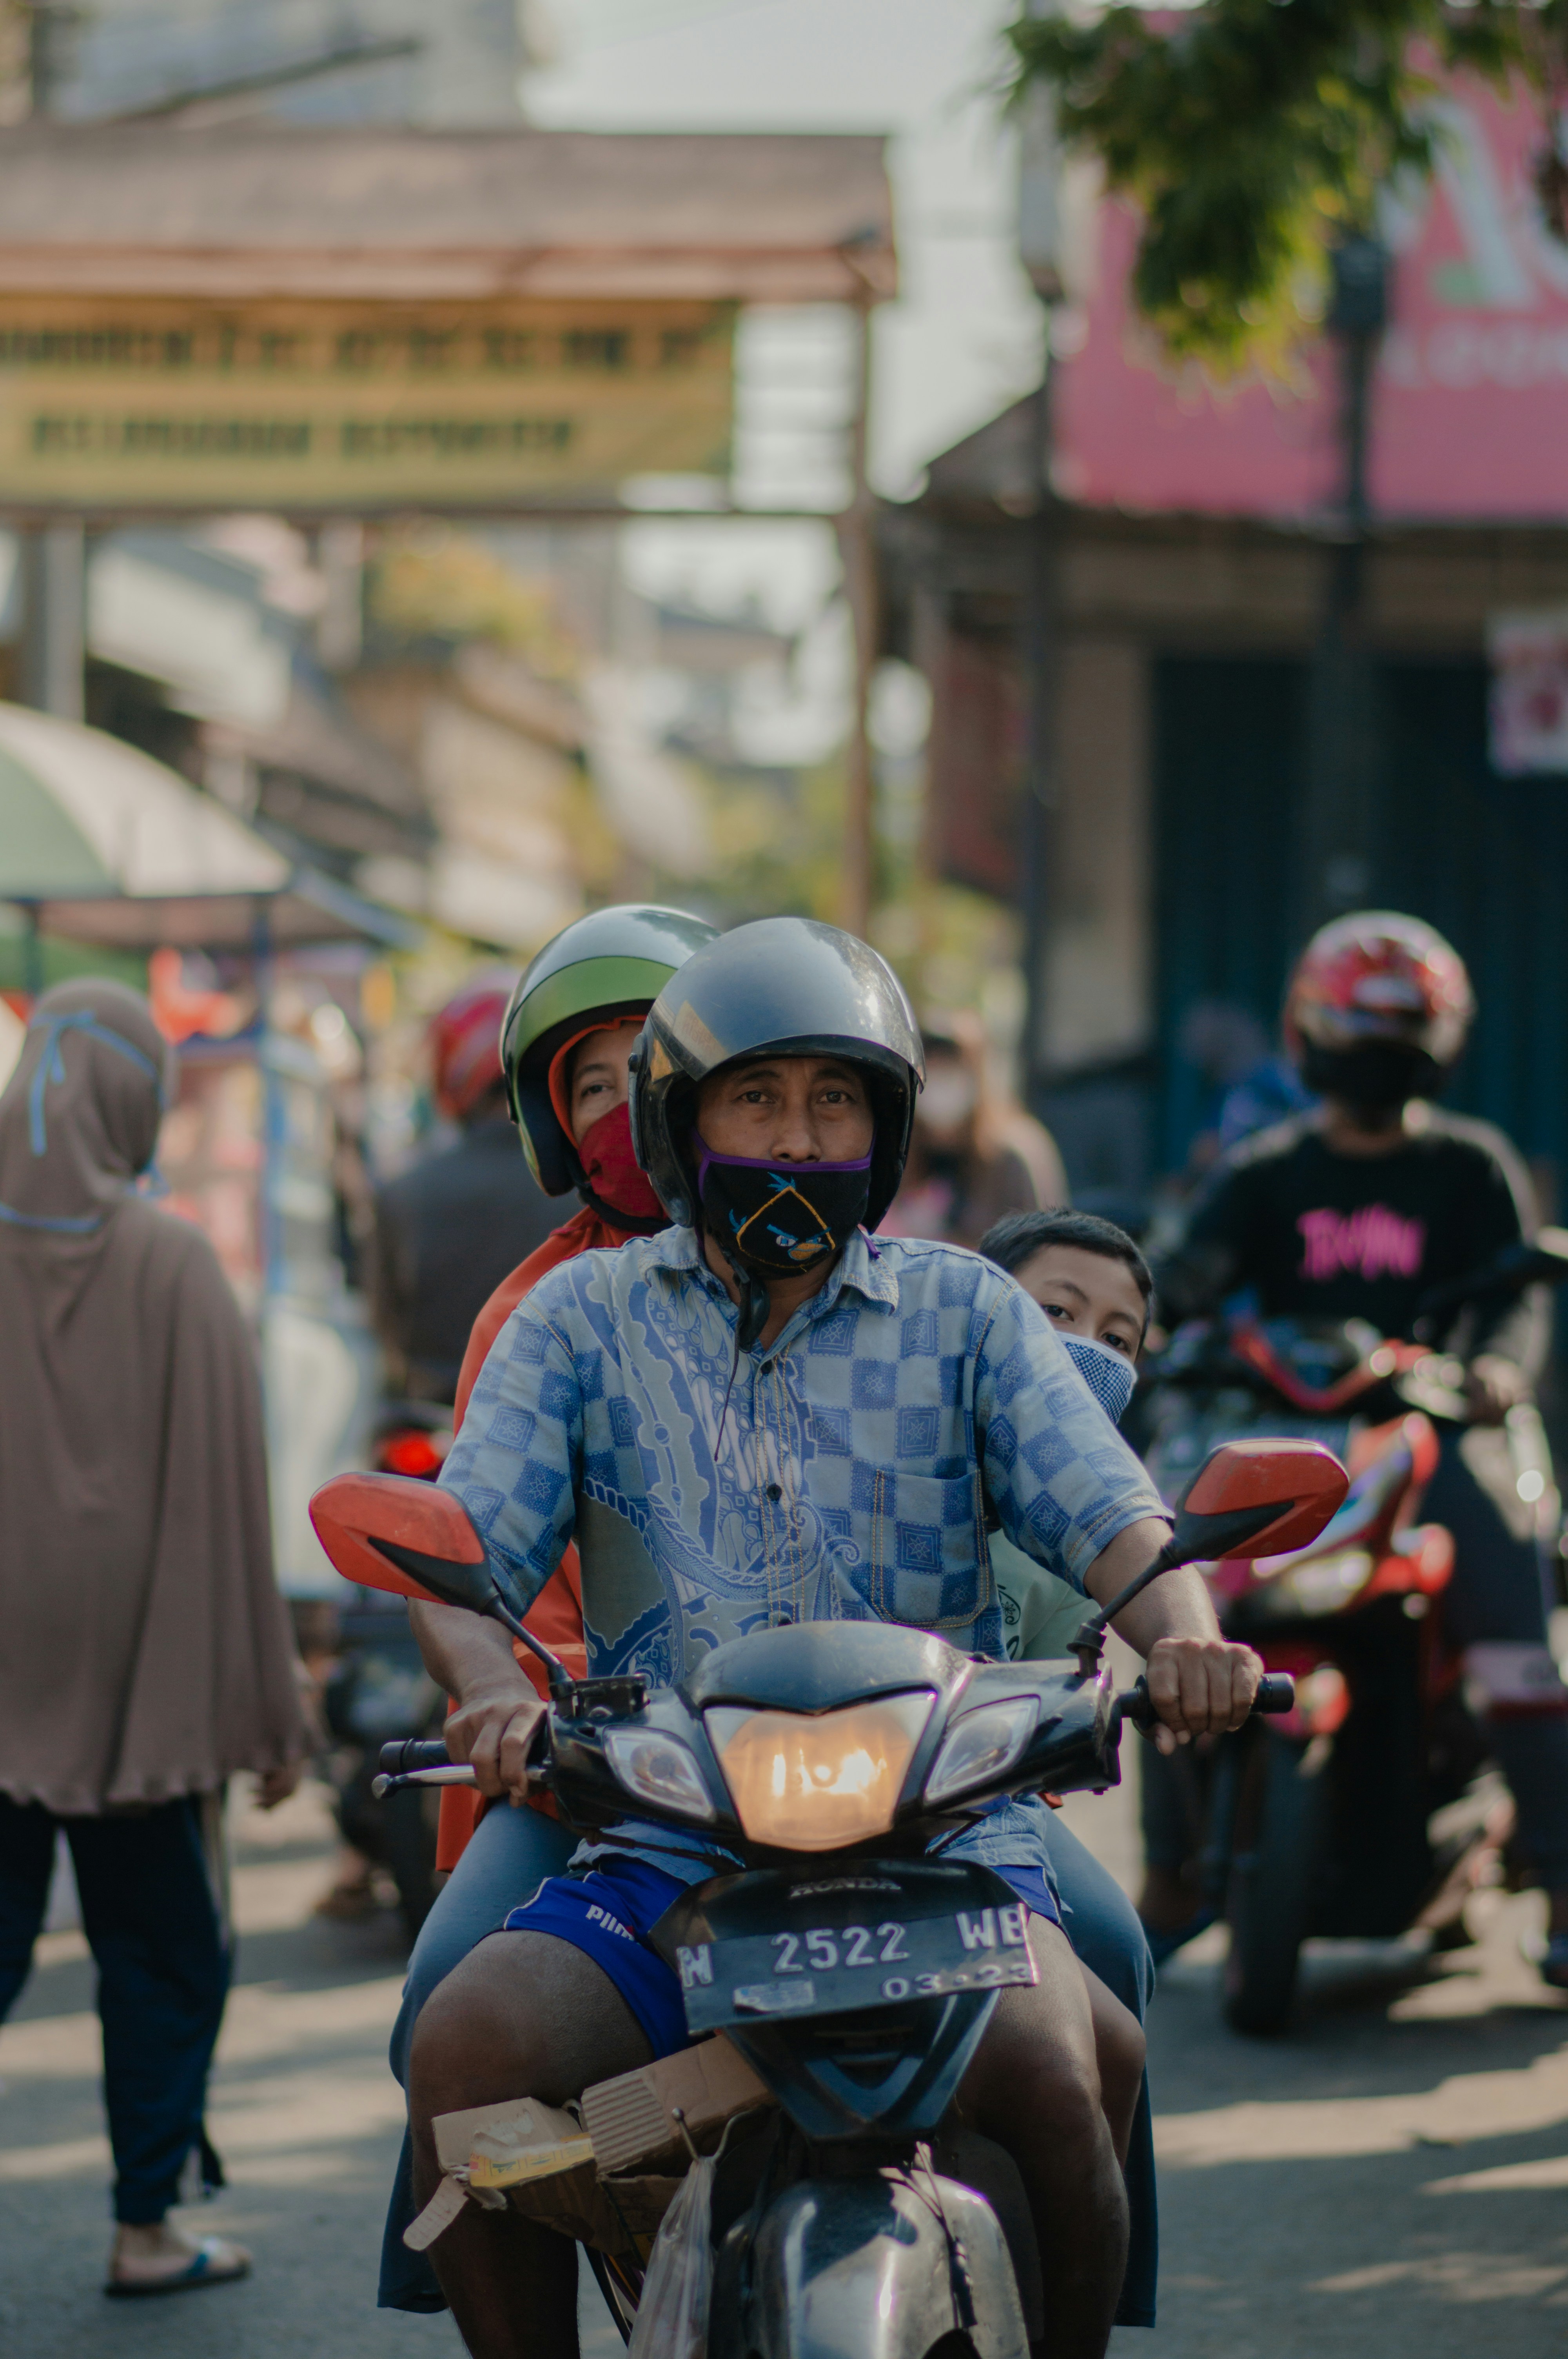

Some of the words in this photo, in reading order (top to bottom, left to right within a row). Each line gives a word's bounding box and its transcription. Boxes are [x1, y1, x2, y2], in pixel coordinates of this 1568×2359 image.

[788, 1877, 902, 1898] HONDA
[676, 1944, 712, 1987] N
[771, 1923, 909, 1973] 2522
